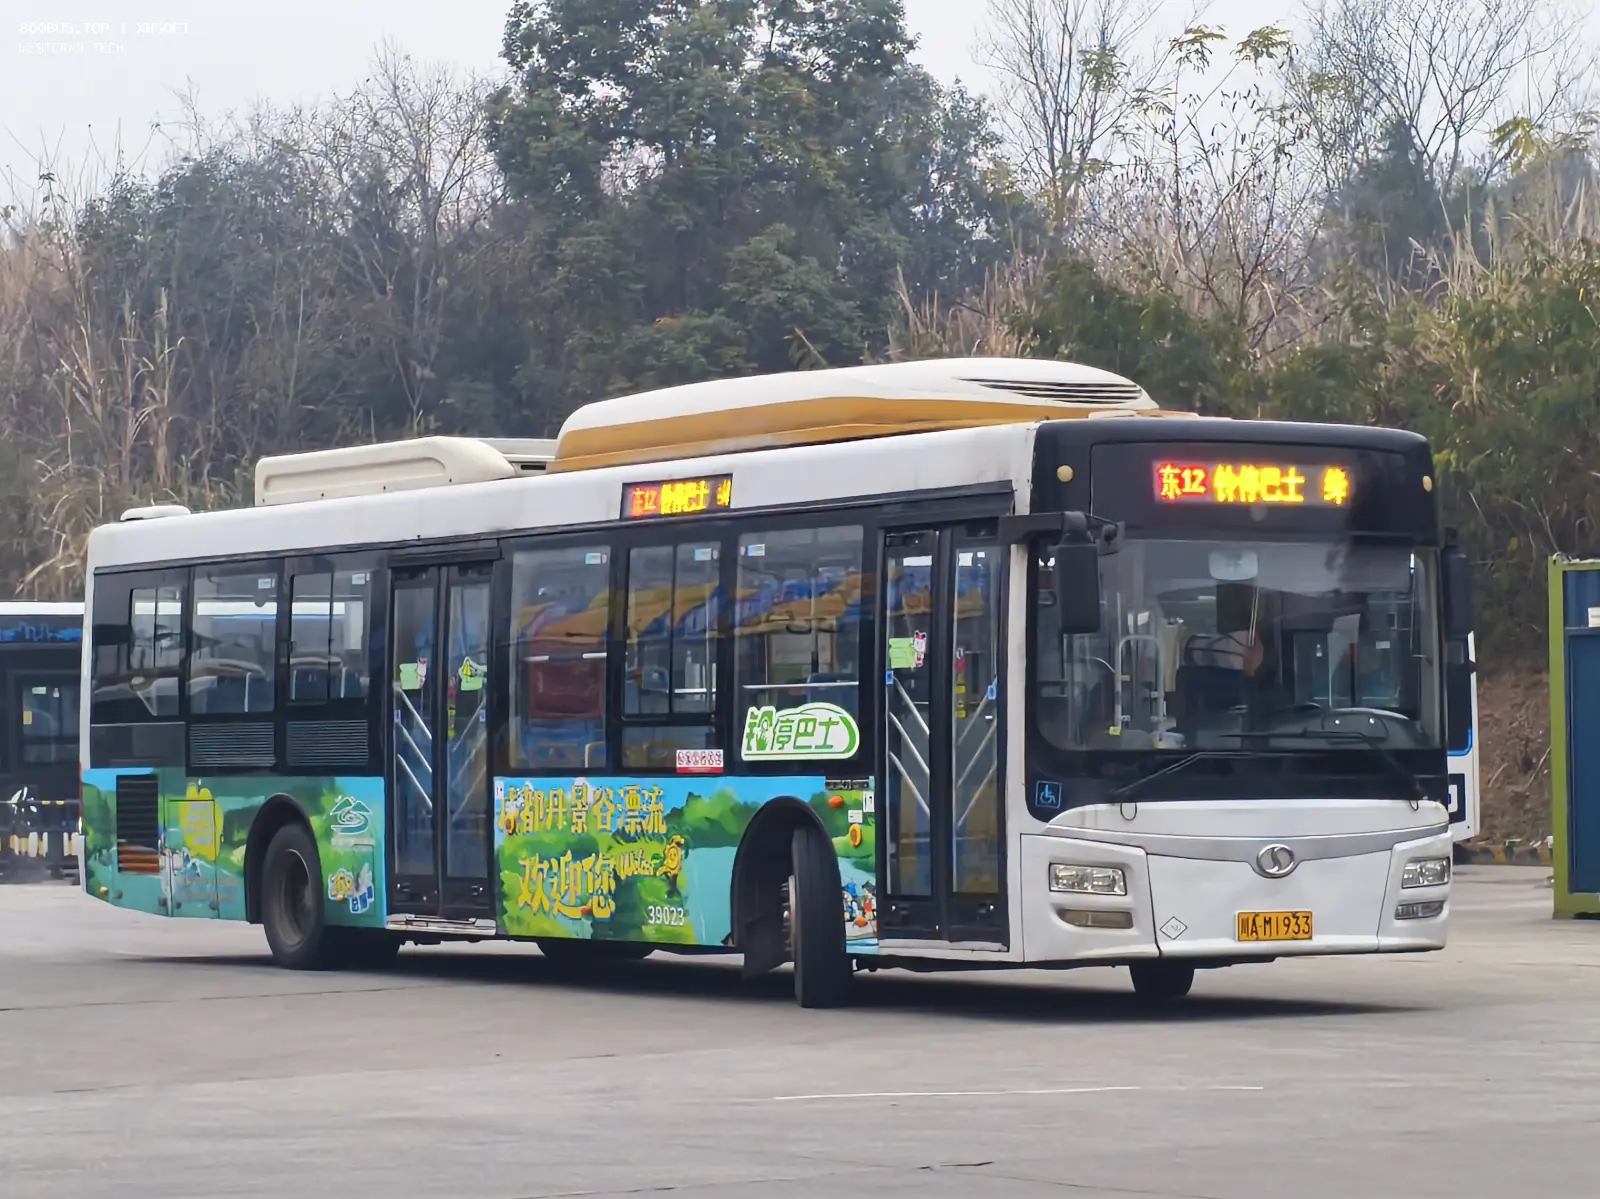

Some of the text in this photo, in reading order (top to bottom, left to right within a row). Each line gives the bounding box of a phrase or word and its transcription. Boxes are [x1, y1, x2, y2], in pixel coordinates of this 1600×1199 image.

[1158, 464, 1207, 499] 东12
[517, 850, 616, 920] 欢迎您
[647, 905, 685, 926] 39023
